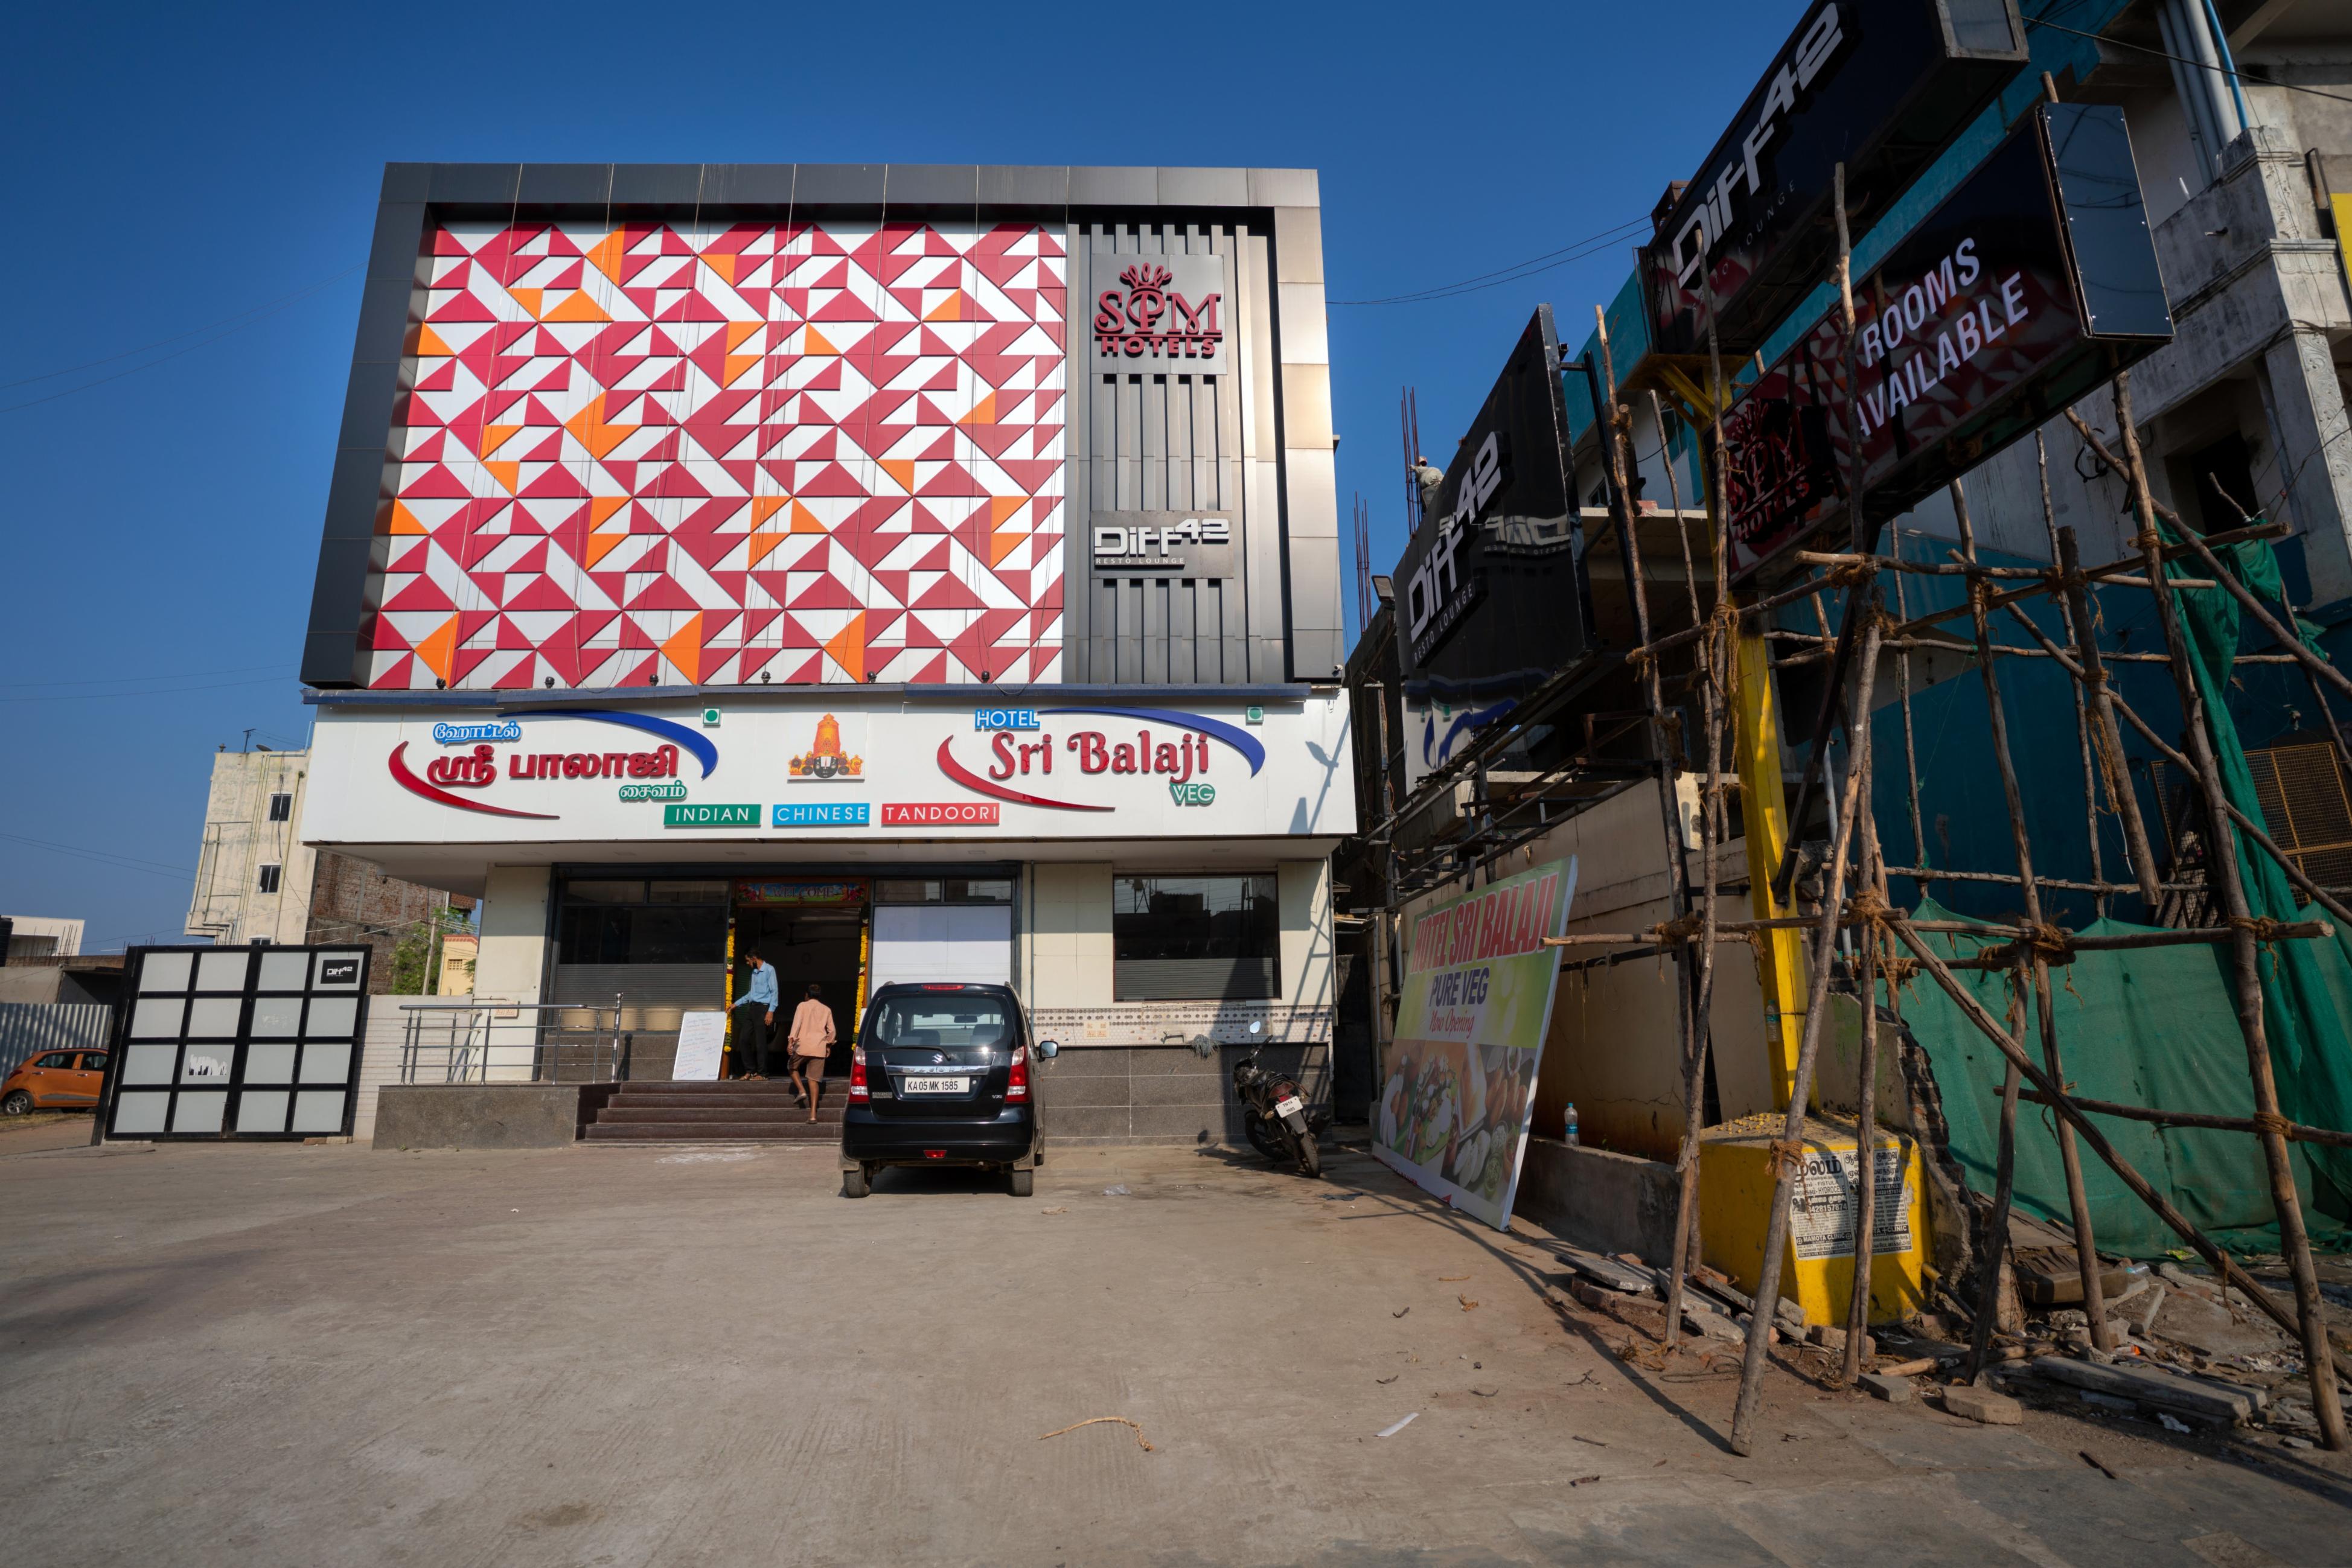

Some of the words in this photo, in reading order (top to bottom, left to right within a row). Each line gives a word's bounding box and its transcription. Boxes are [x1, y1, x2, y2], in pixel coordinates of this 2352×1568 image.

[1095, 289, 1222, 335] SPM
[1862, 237, 1981, 369] ROOMS
[1101, 336, 1216, 357] HOTELS
[1414, 630, 1434, 664] RESTO
[1439, 583, 1472, 633] LOUNGE
[975, 709, 1041, 730] HOTEL
[433, 720, 522, 744] ஹோட்டல்
[509, 744, 679, 779] பாலாஜி
[989, 731, 1052, 779] Sri
[1067, 730, 1209, 783] Balaji
[619, 779, 689, 801] சைவம்
[1170, 783, 1216, 806] VEG
[675, 808, 750, 823] INDIAN
[776, 805, 867, 821] CHINESE
[886, 806, 998, 821] TANDOORI
[772, 885, 834, 898] WELCOME
[1410, 908, 1450, 975] HOTEL
[1448, 895, 1480, 967] SRI
[1478, 872, 1560, 961] BALAJI
[1429, 970, 1461, 1007] PURE
[1462, 967, 1490, 1005] VEG
[1429, 1009, 1445, 1033] Now
[1445, 1006, 1475, 1039] Opening
[907, 1082, 918, 1091] KA
[919, 1082, 927, 1091] 05
[929, 1081, 939, 1090] MK
[941, 1081, 958, 1090] 1585
[1818, 1185, 1845, 1194] HYDROCELE
[1803, 1234, 1827, 1243] MAMOTA
